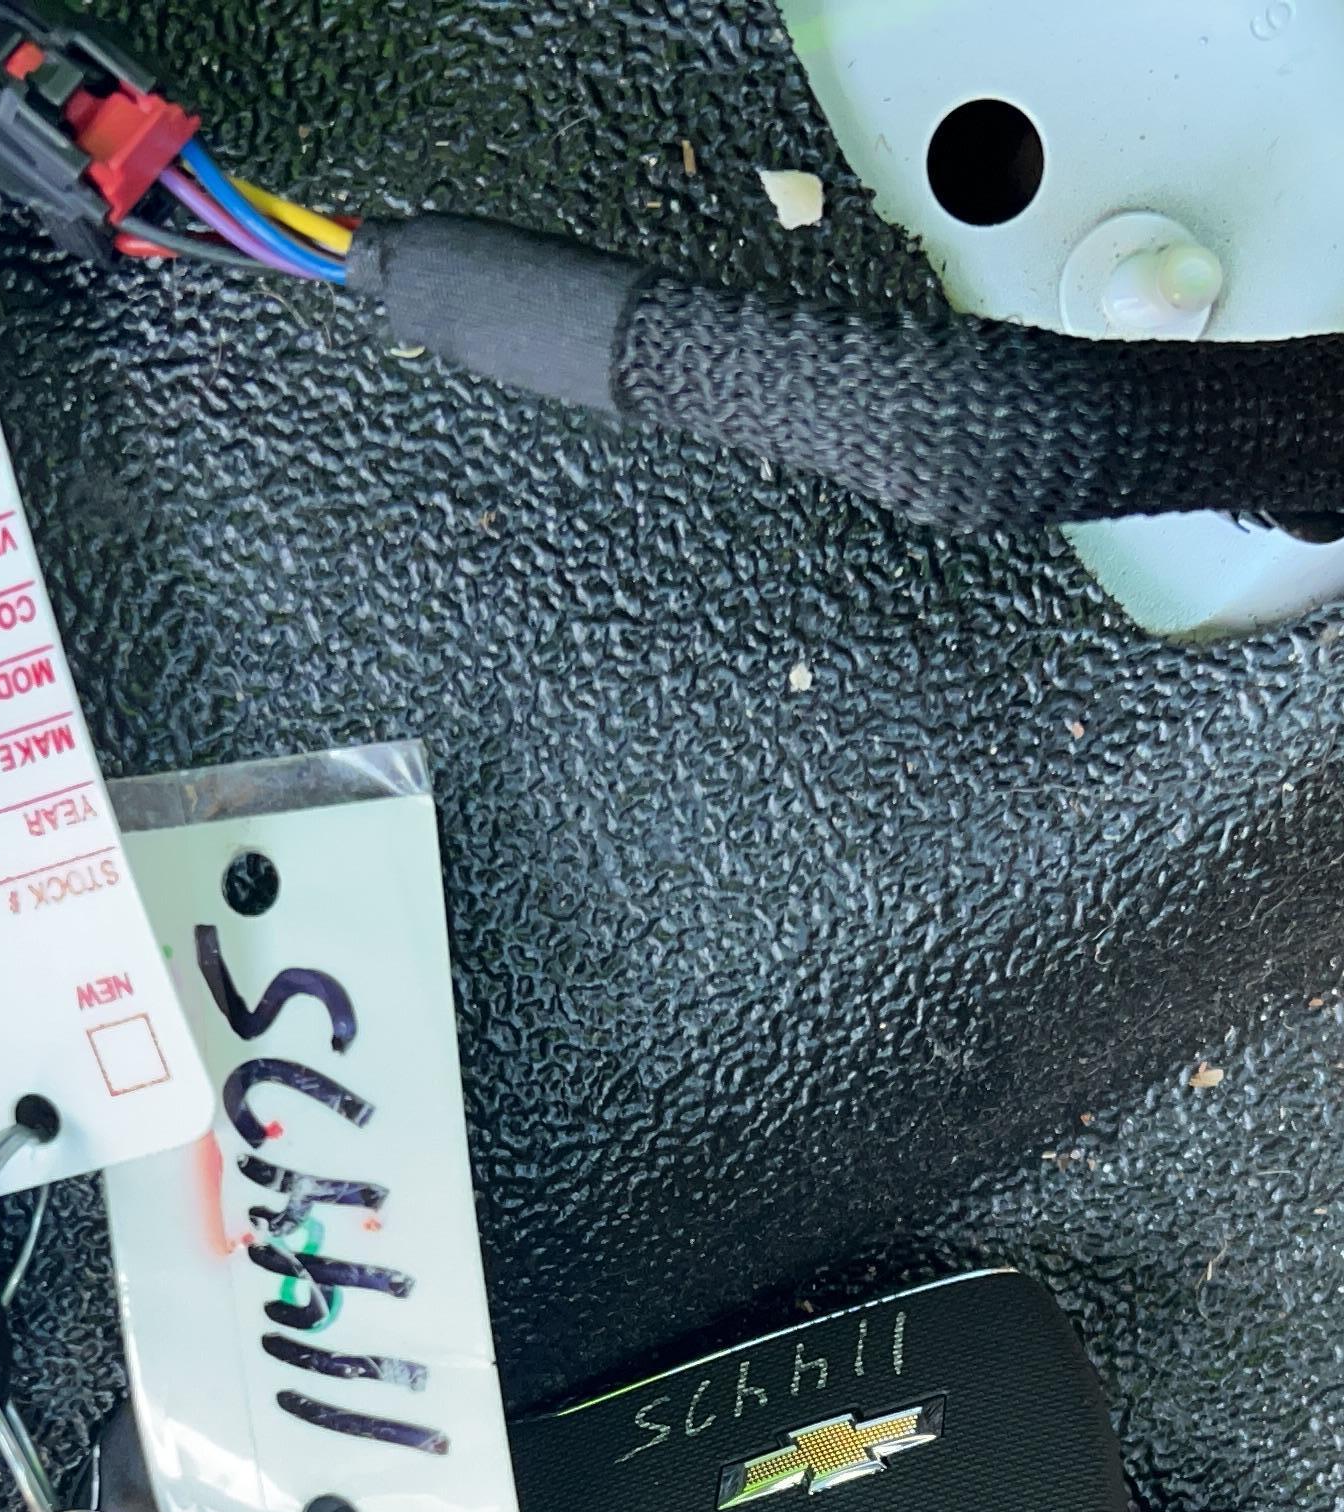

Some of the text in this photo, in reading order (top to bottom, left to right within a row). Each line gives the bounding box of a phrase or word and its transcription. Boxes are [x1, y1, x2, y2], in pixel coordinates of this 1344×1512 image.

[22, 793, 99, 838] YEAR
[8, 859, 121, 915] STOCK #
[75, 971, 136, 1012] NEW
